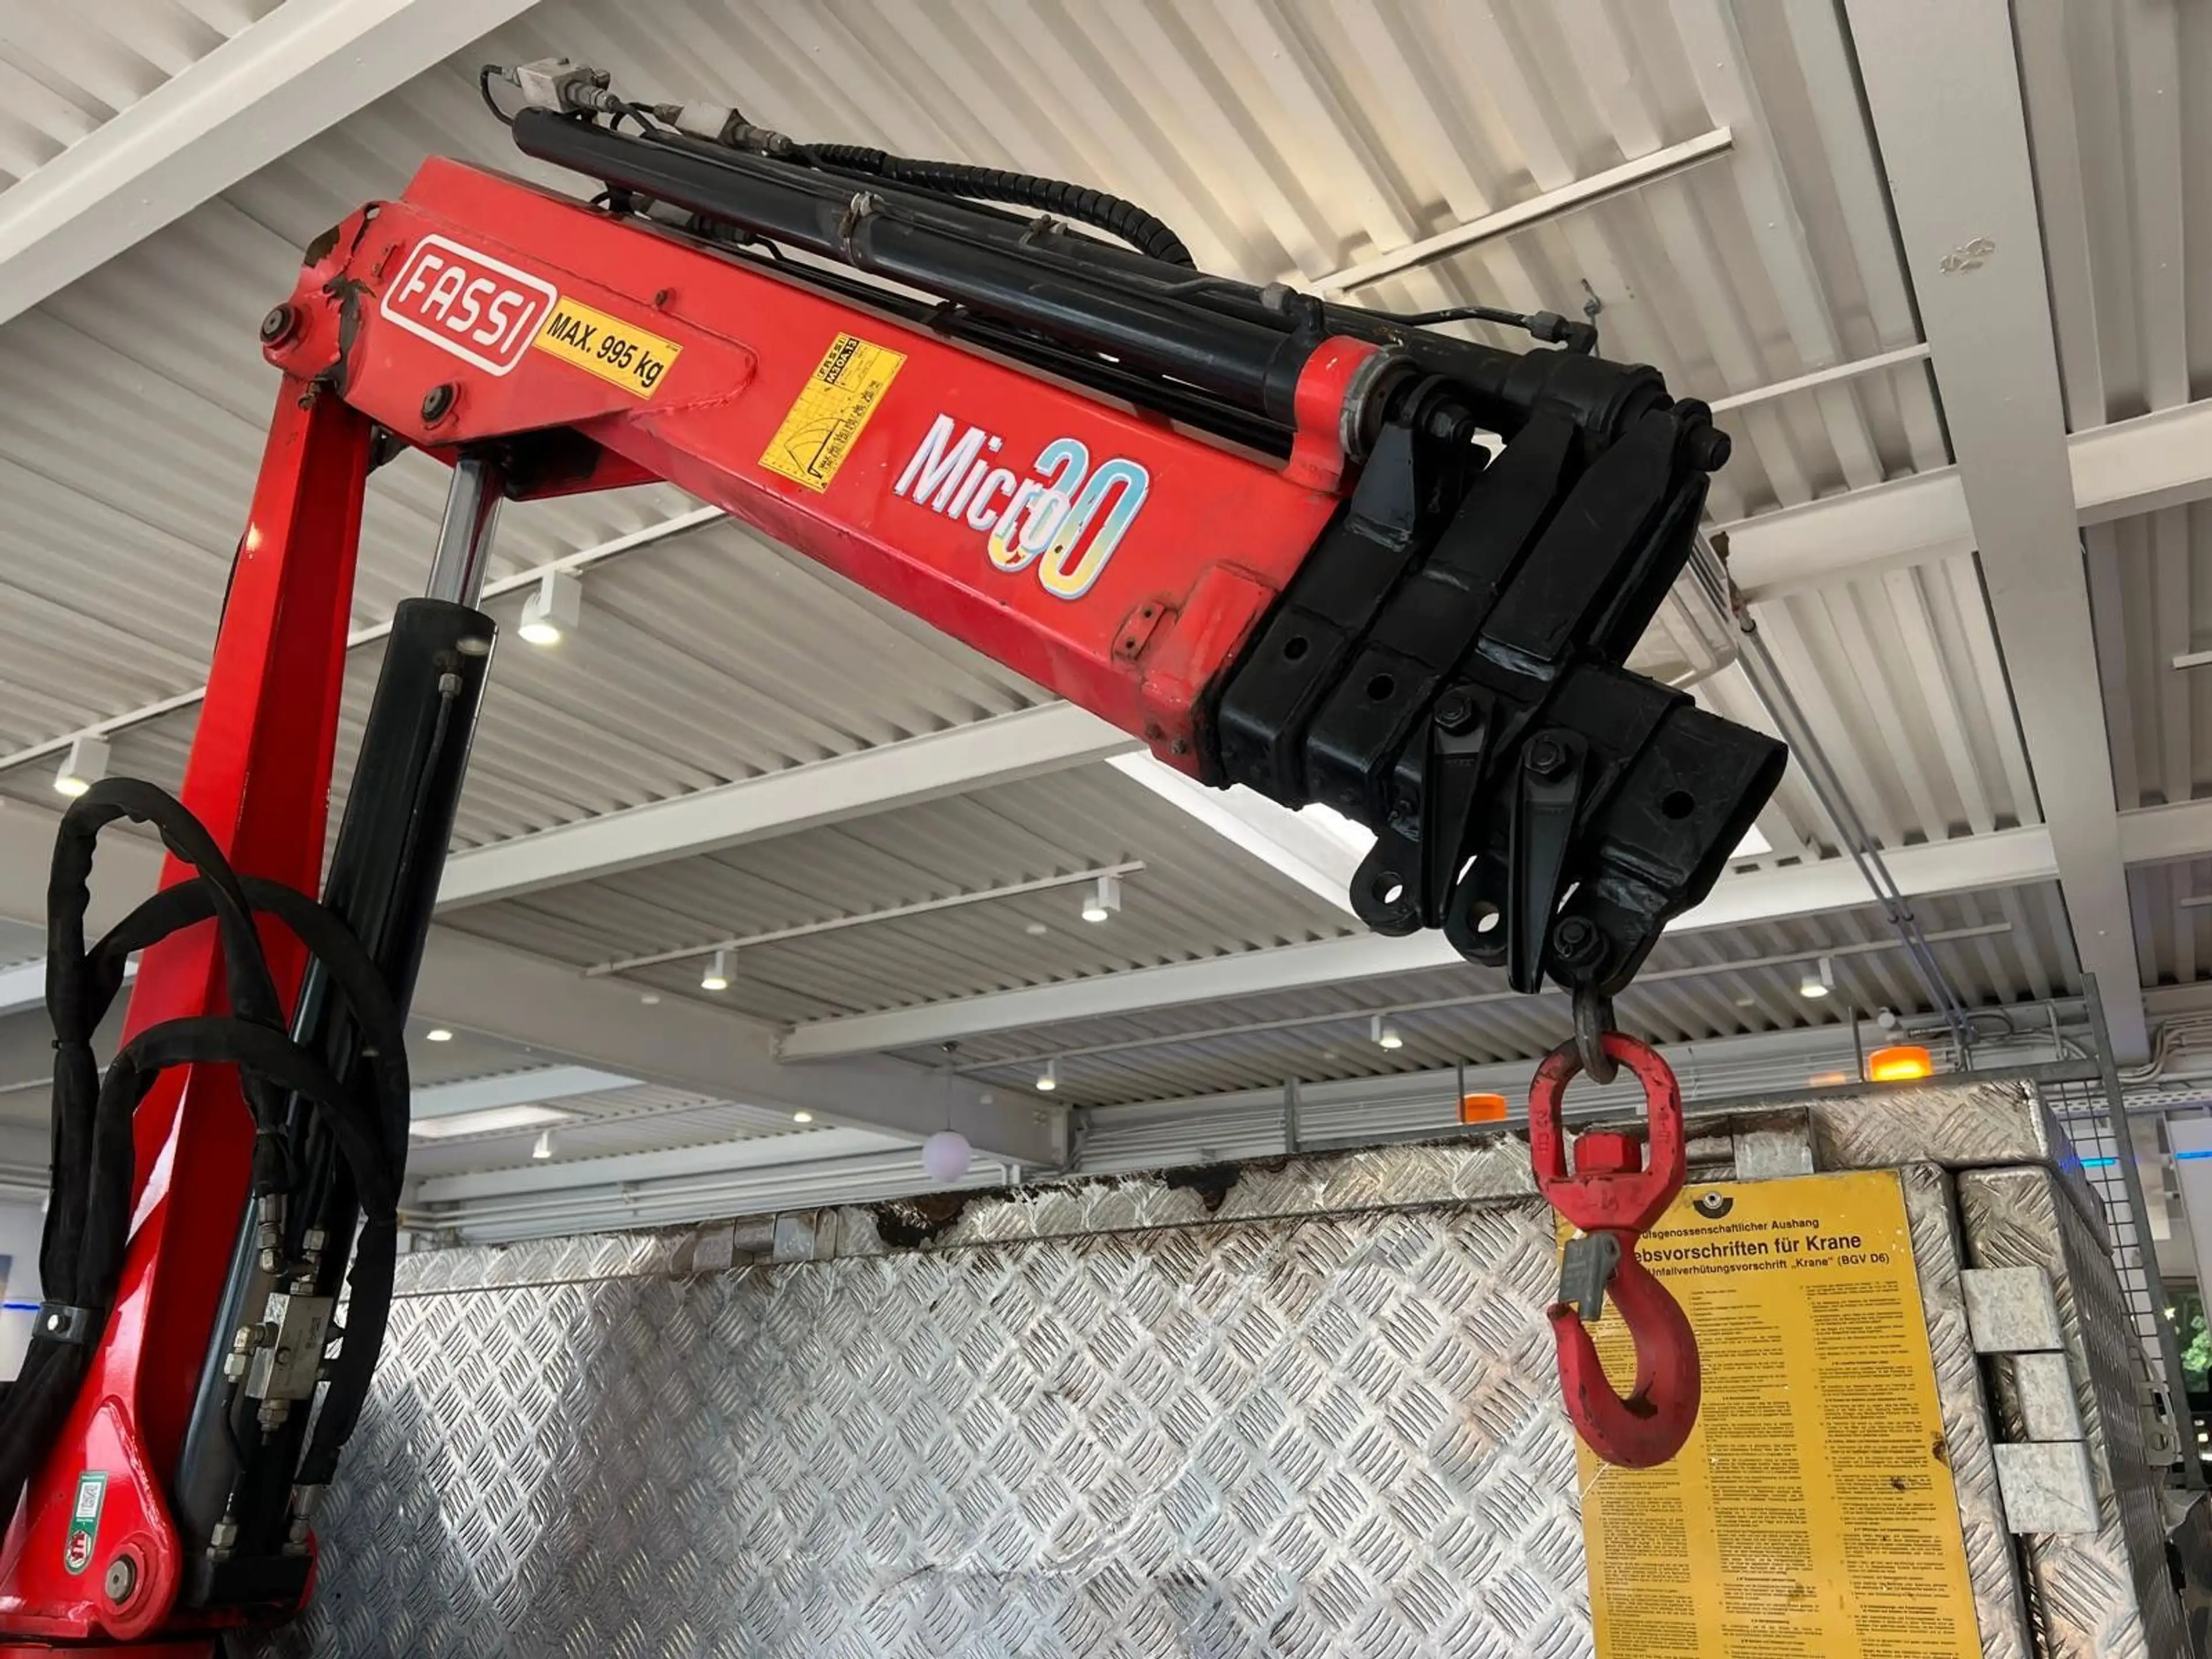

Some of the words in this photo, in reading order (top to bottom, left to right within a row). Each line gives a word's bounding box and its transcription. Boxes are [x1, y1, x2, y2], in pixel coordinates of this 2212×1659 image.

[398, 253, 536, 354] FASSI
[546, 312, 597, 353] MAX.
[597, 335, 637, 369] 995
[633, 349, 664, 388] kg
[893, 412, 1070, 553] Micro
[987, 437, 1150, 600] 30
[1634, 1240, 1768, 1263] ebsvorschriften
[1774, 1237, 1800, 1253] für
[1805, 1234, 1862, 1252] Krane
[1771, 1219, 1819, 1229] Aushang
[1838, 1253, 1866, 1267] (BGV
[1870, 1252, 1890, 1264] D6)
